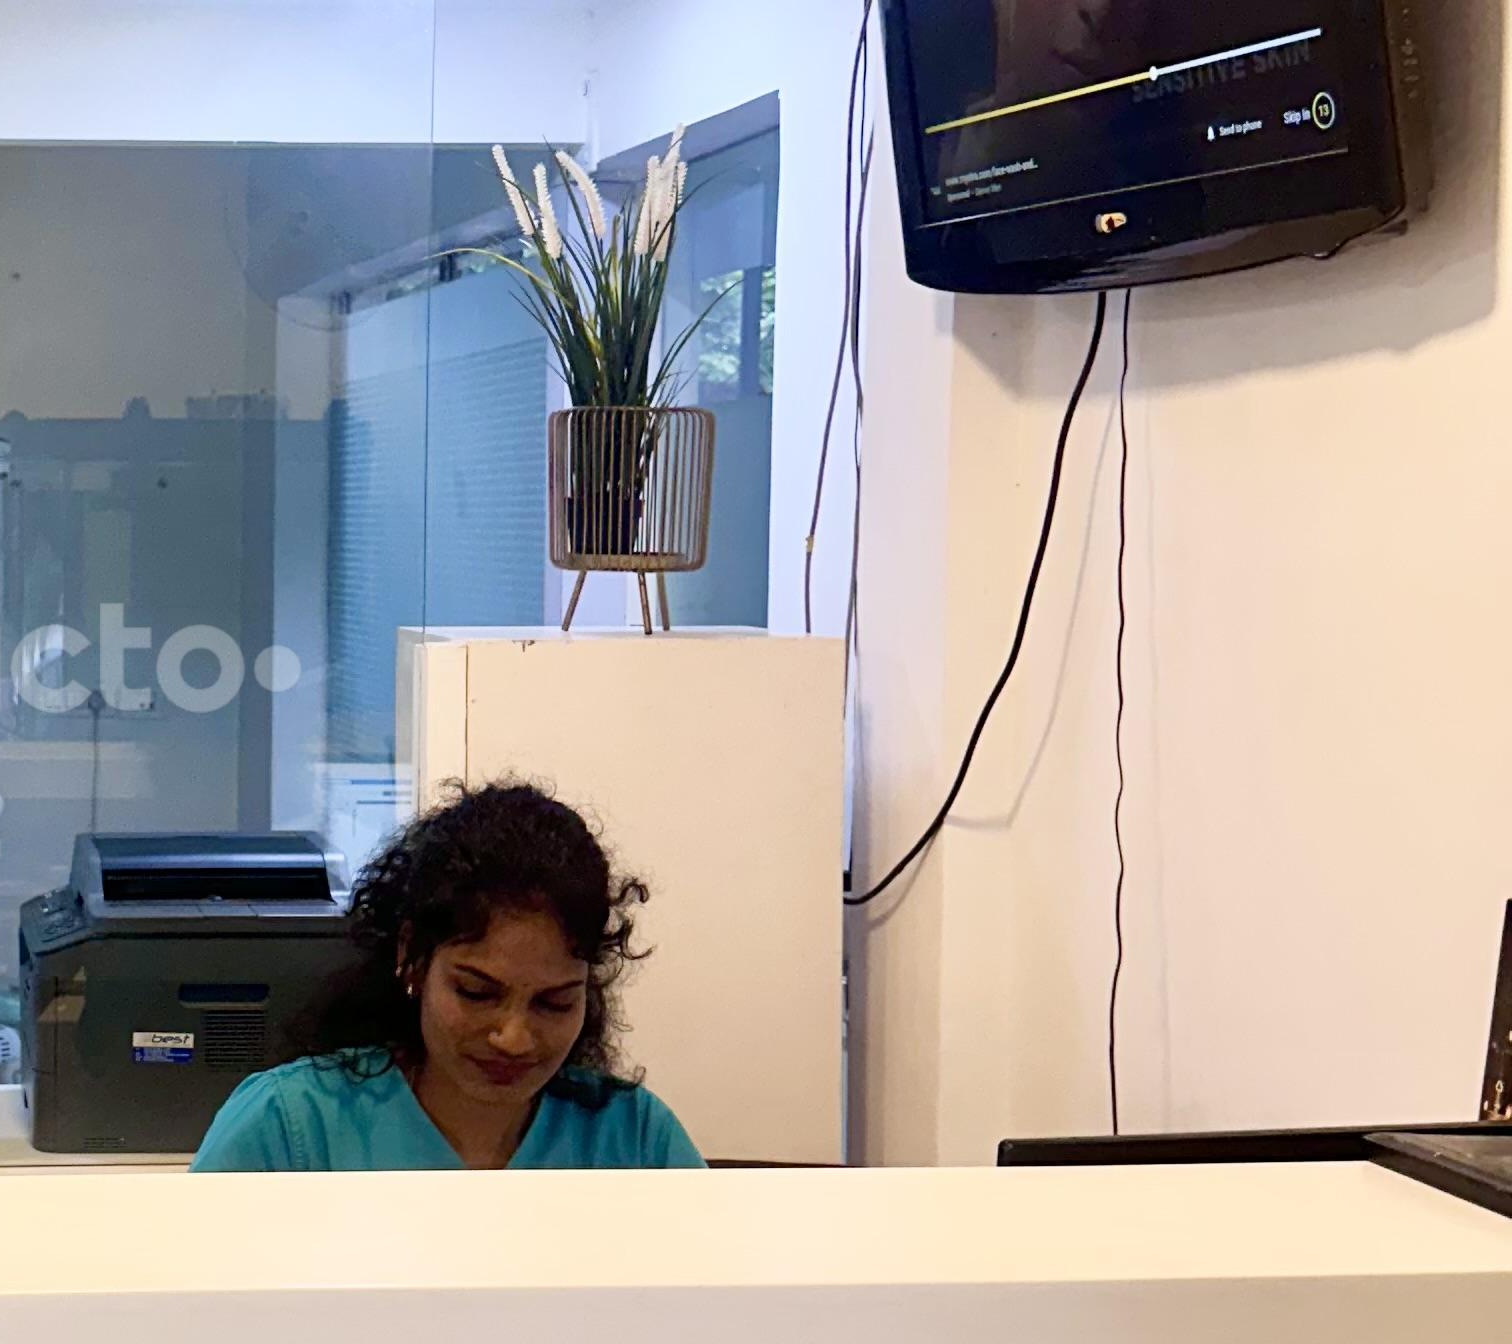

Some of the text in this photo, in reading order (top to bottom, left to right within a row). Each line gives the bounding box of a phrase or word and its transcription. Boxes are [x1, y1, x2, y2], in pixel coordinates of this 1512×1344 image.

[1283, 110, 1301, 125] Skip
[1317, 104, 1330, 118] 13
[1242, 119, 1263, 135] phone
